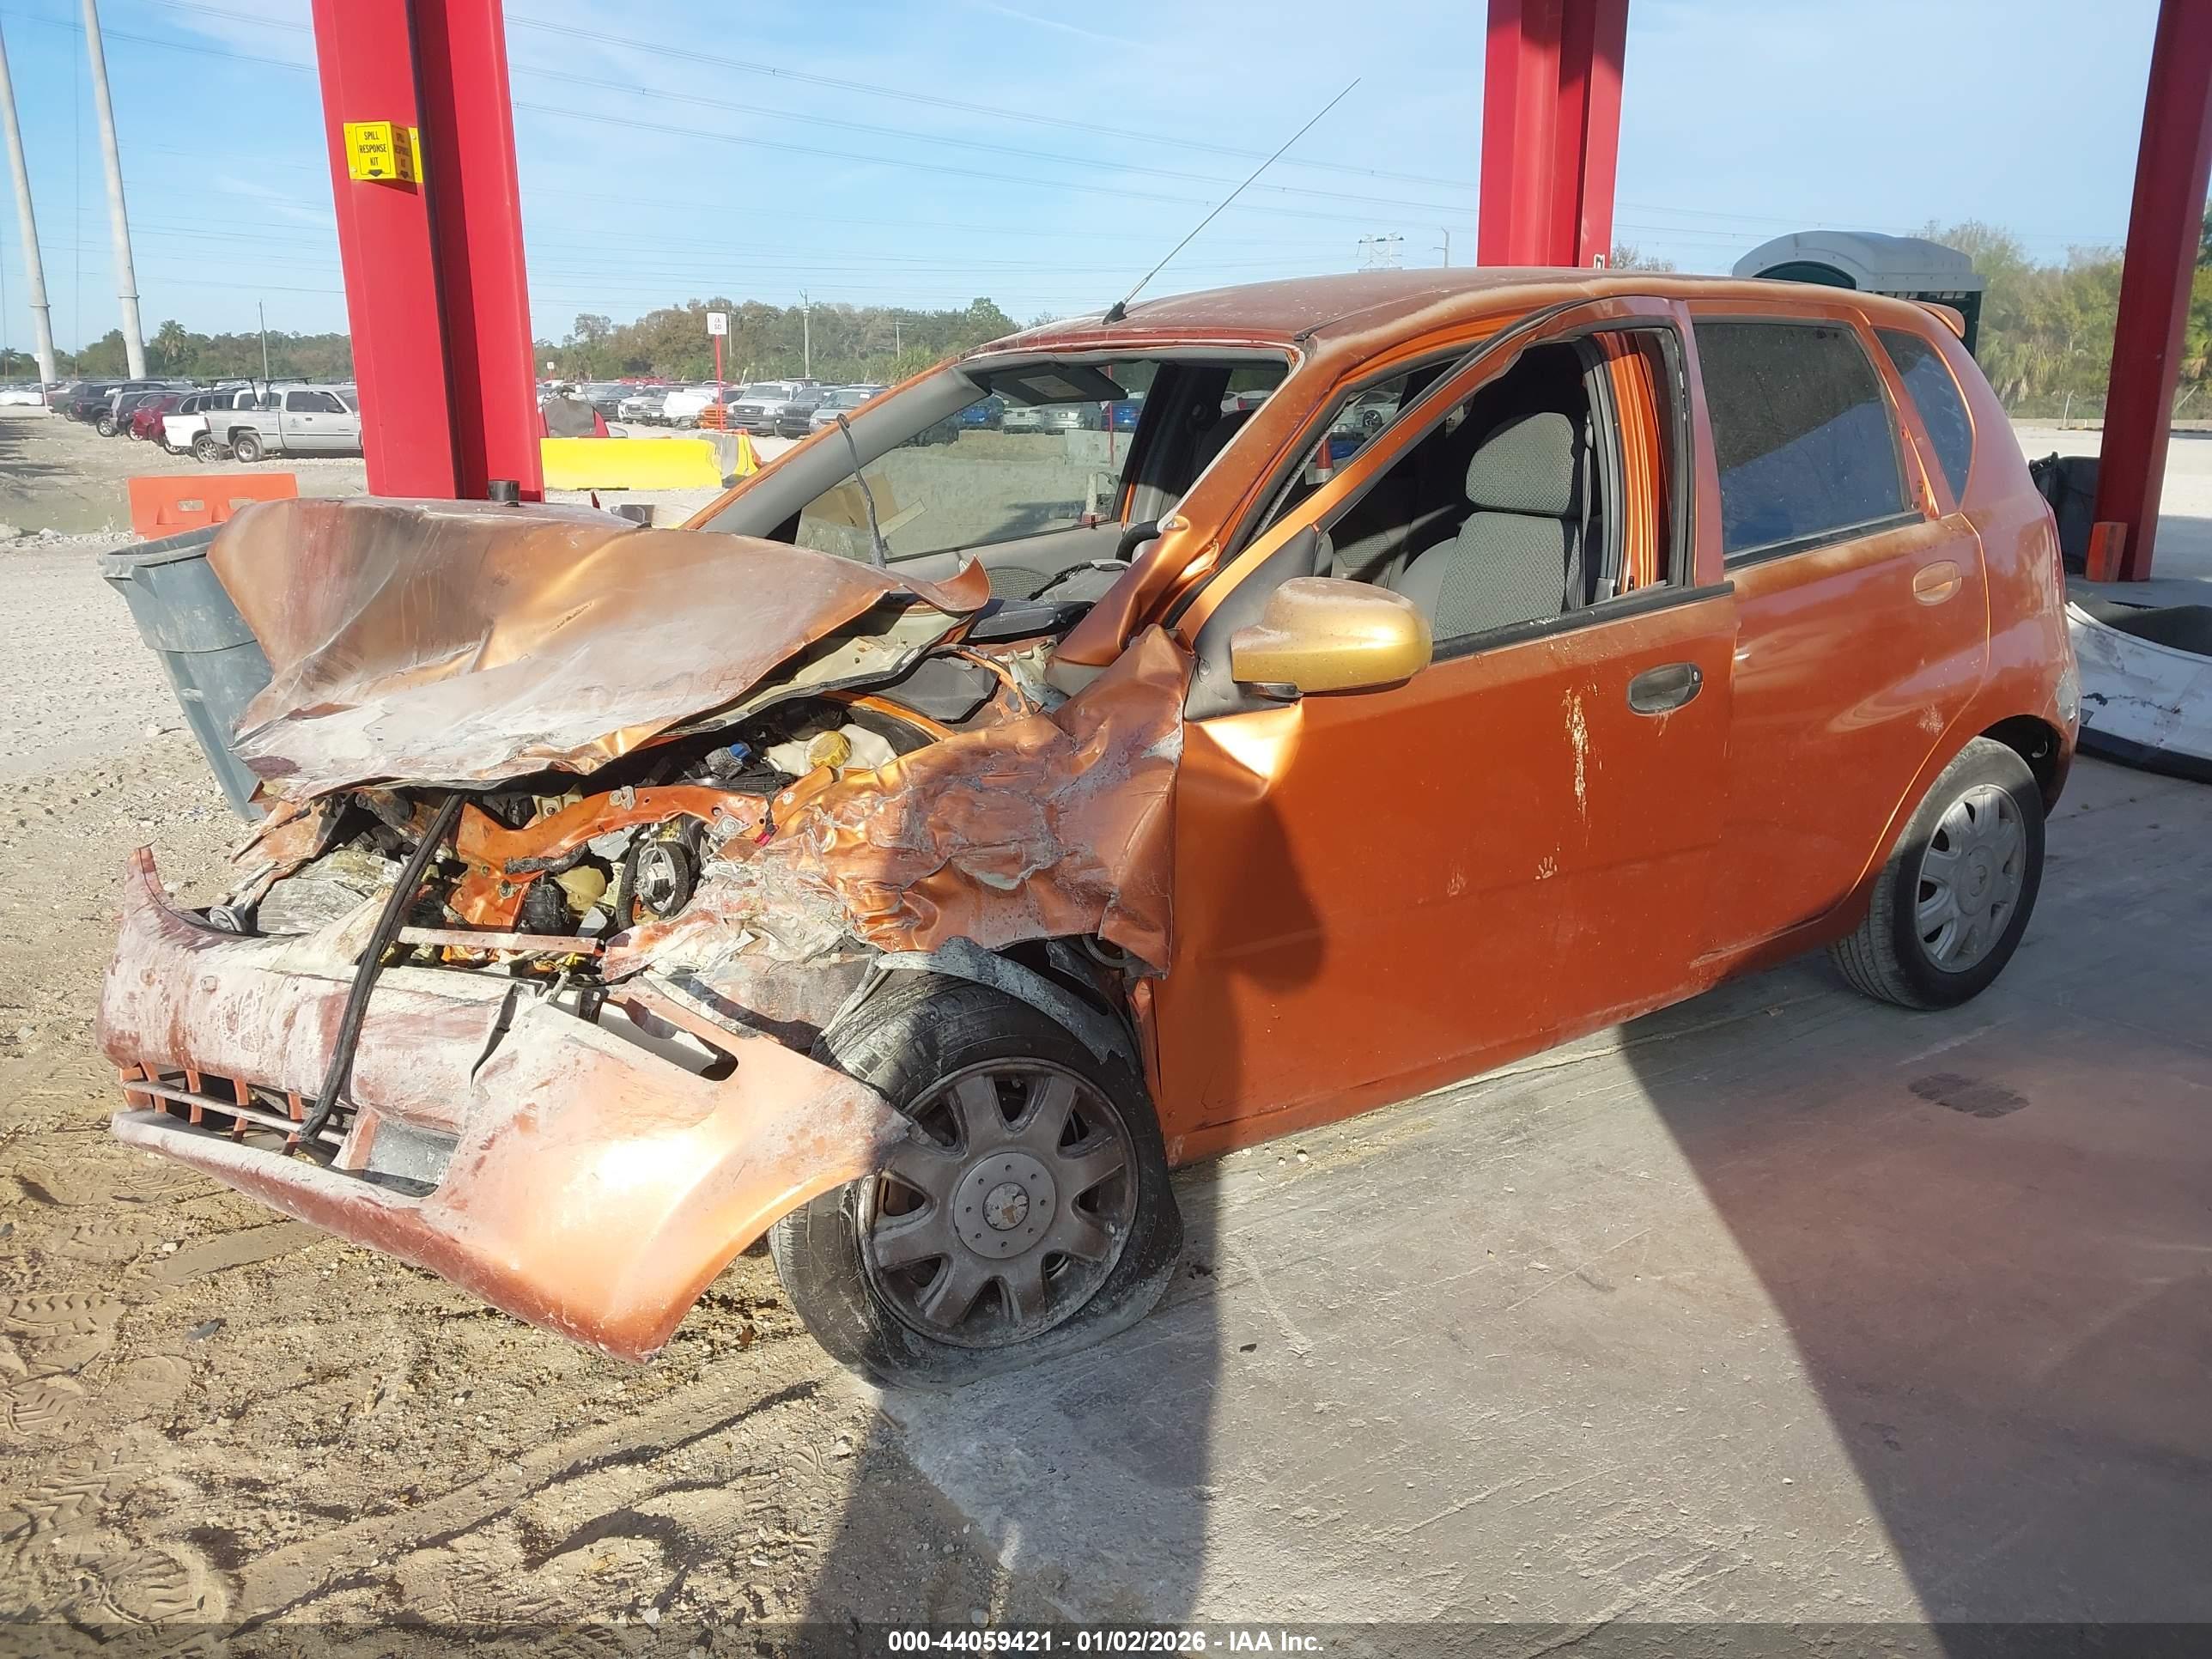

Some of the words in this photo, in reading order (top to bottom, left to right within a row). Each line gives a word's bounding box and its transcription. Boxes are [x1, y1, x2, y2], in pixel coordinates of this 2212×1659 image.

[364, 131, 380, 140] SPILL
[359, 144, 387, 153] RESPONSE
[370, 157, 379, 166] KIT
